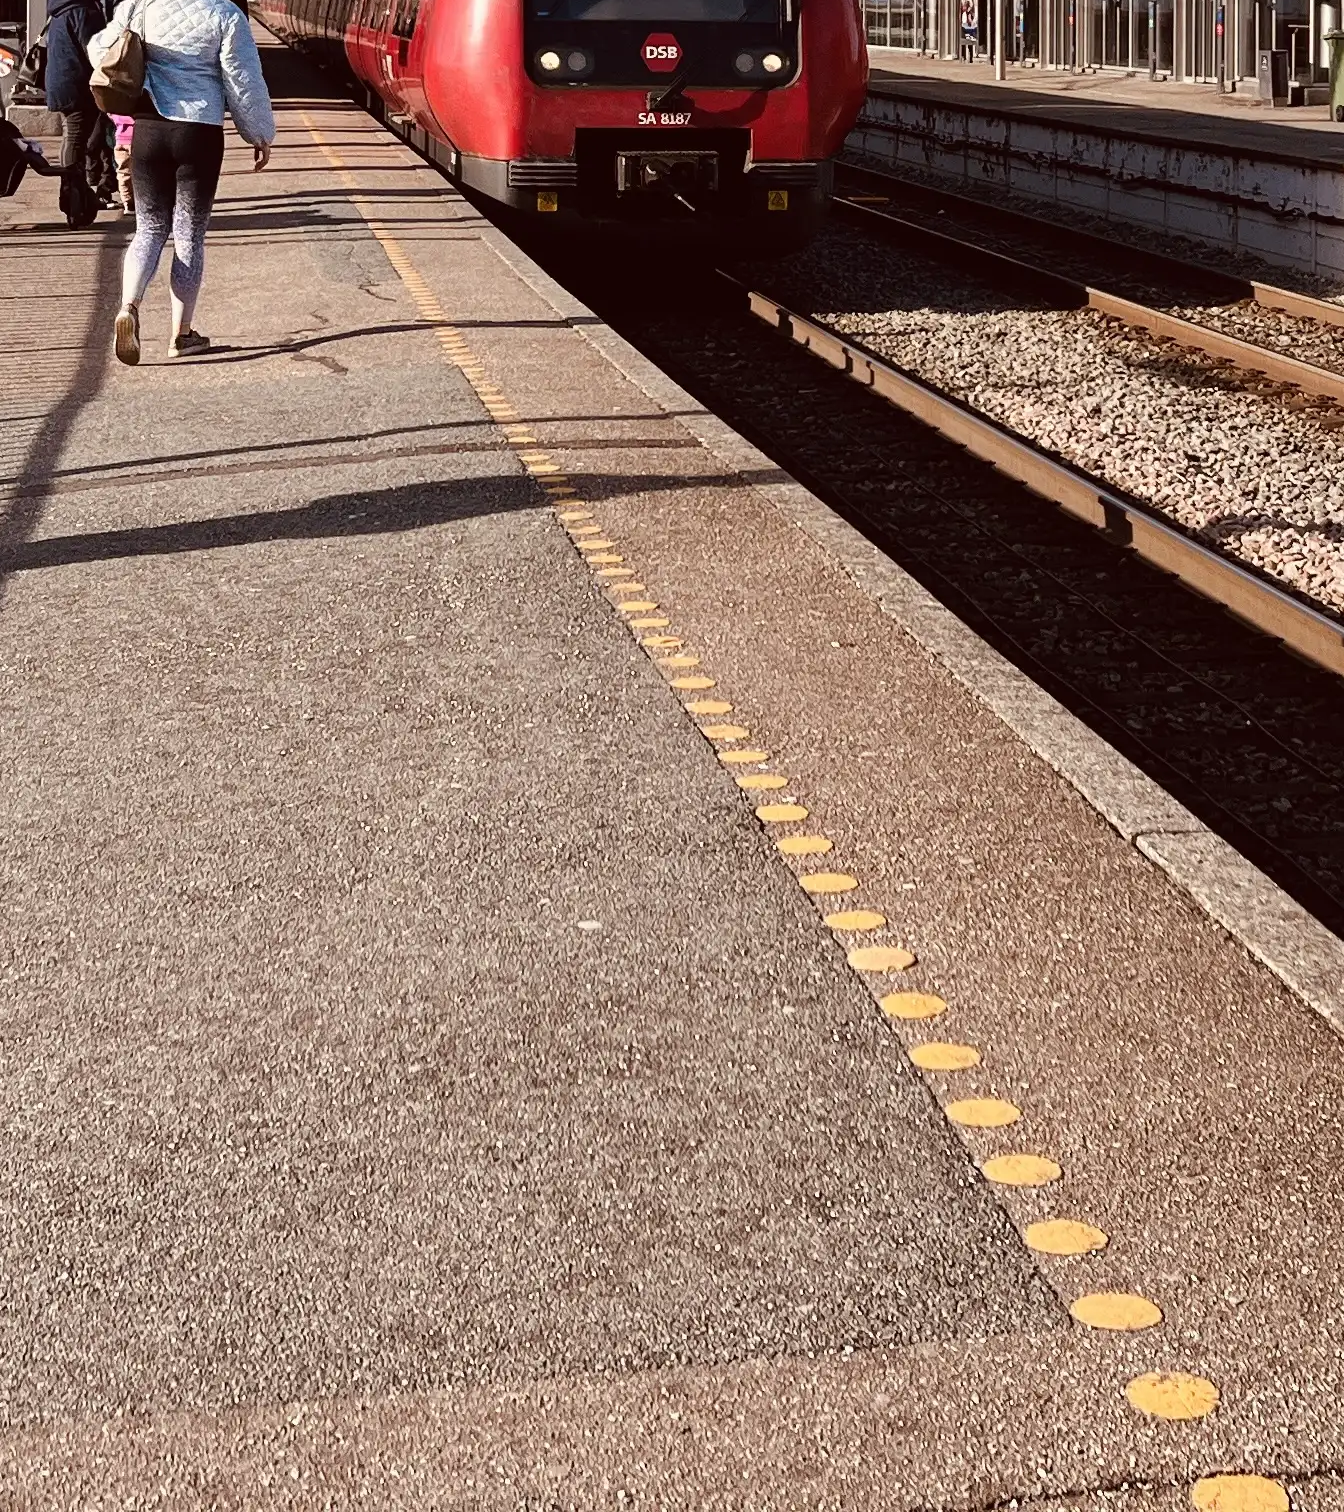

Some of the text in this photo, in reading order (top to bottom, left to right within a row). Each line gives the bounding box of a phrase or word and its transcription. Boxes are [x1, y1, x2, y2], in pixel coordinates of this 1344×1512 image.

[646, 46, 677, 58] DSB
[638, 113, 691, 124] SA 8187
